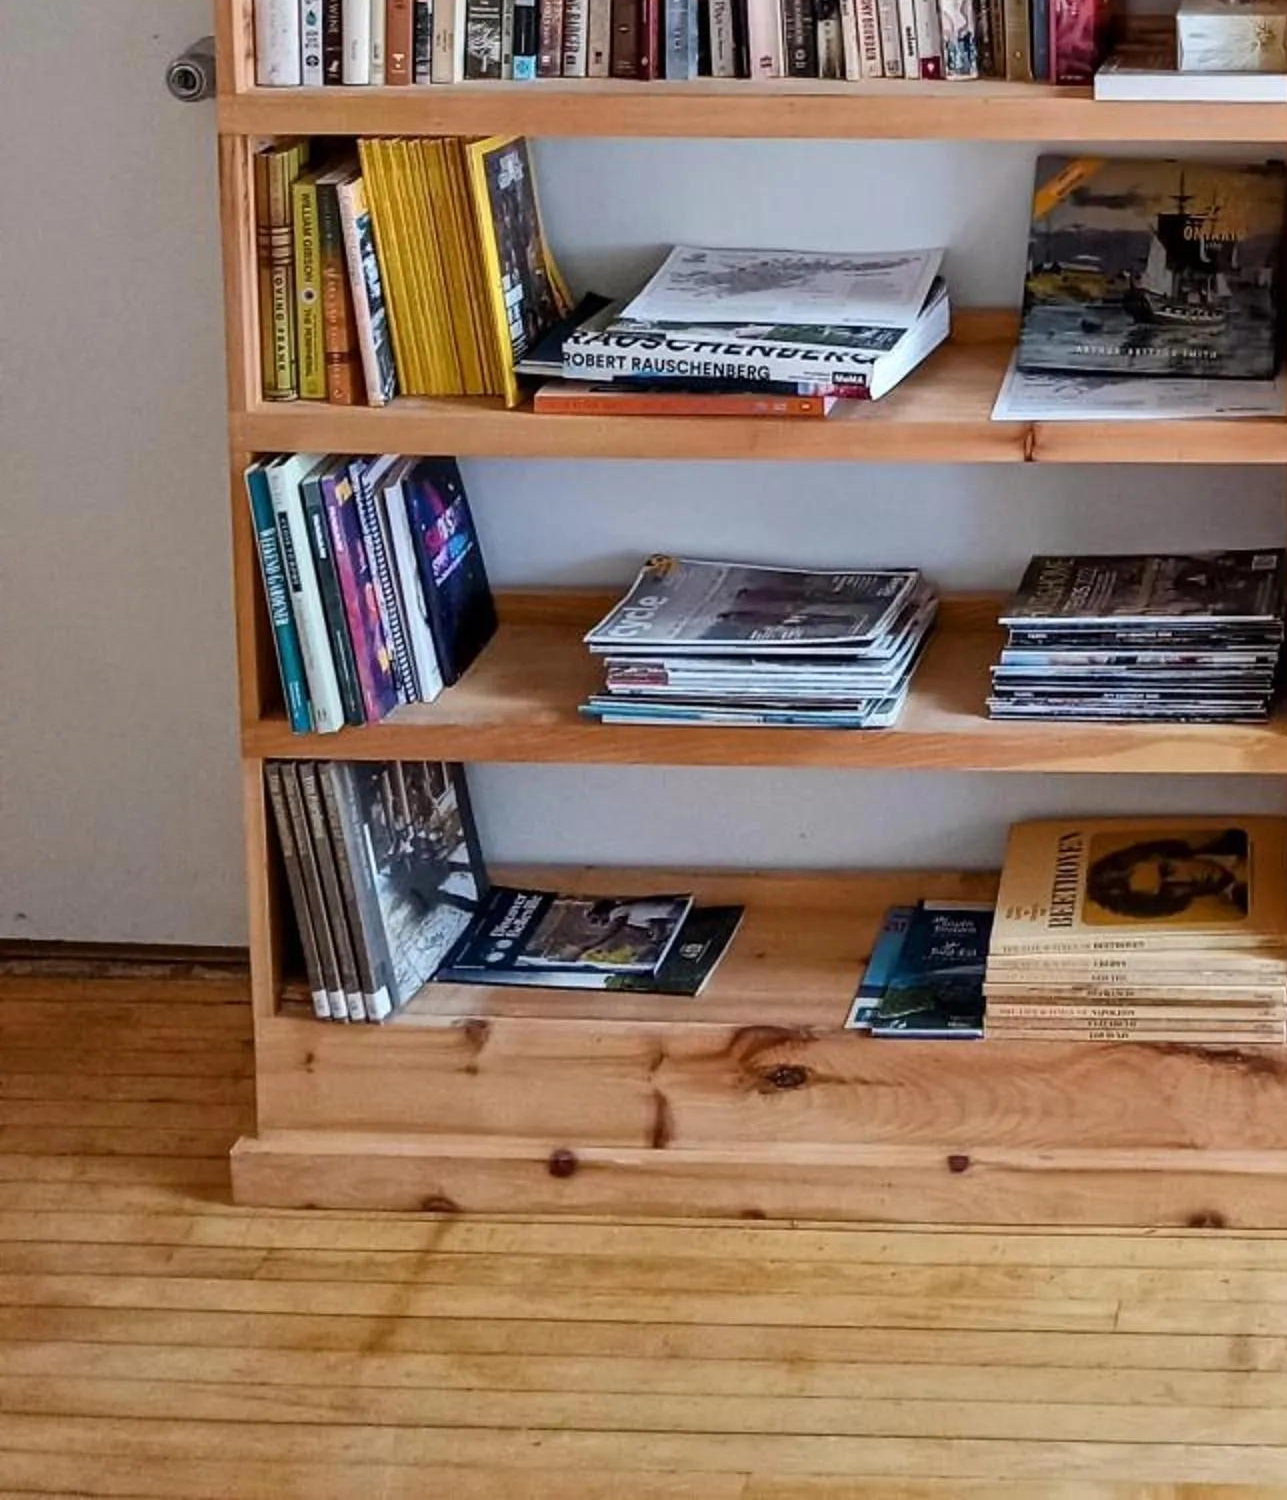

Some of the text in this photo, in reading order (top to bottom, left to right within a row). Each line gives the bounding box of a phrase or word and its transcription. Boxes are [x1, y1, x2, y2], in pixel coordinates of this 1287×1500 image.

[328, 4, 338, 34] WINE
[301, 193, 313, 283] WILLIAM GIBSON
[562, 351, 771, 380] ROBERT RAUSCHENBERG
[1048, 830, 1084, 929] BEETHOVEN
